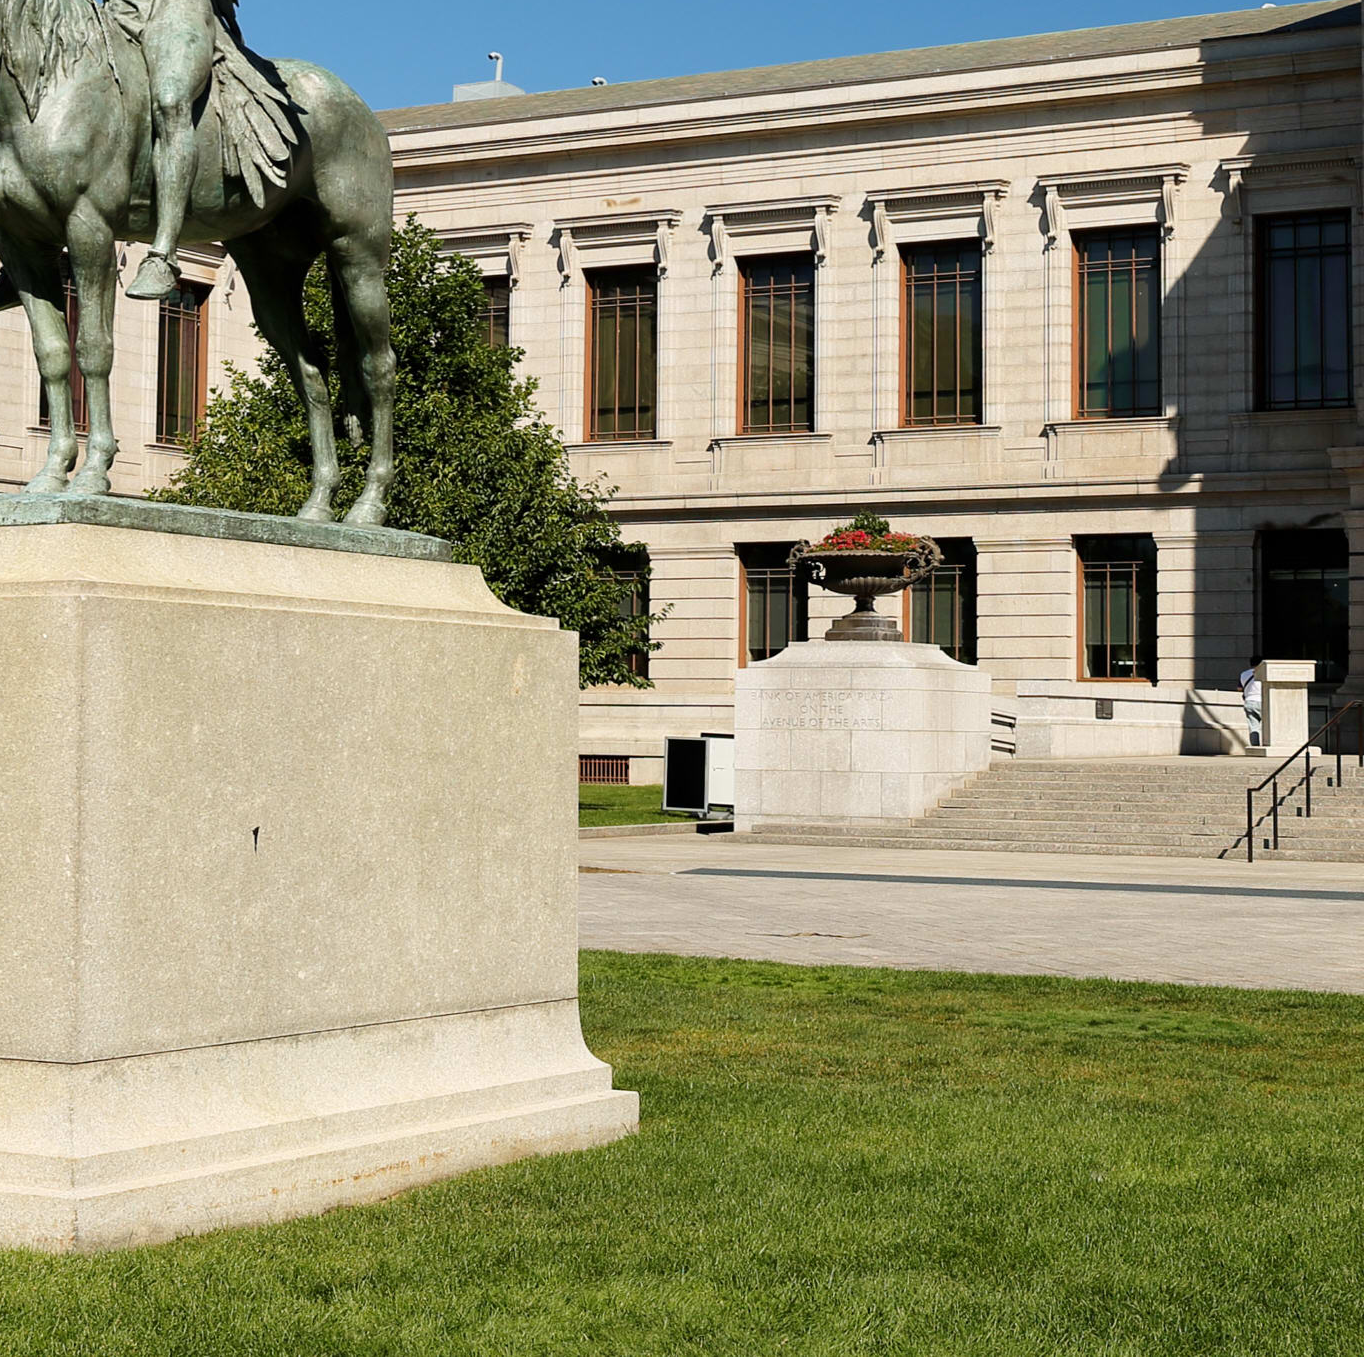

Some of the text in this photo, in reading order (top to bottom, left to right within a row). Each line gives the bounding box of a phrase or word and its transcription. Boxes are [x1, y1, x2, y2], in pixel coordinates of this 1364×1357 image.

[751, 691, 893, 702] BANK OF AMERICA PLAZA
[799, 705, 843, 715] ON THE
[763, 716, 881, 729] AVENUE OF THE ARTS
